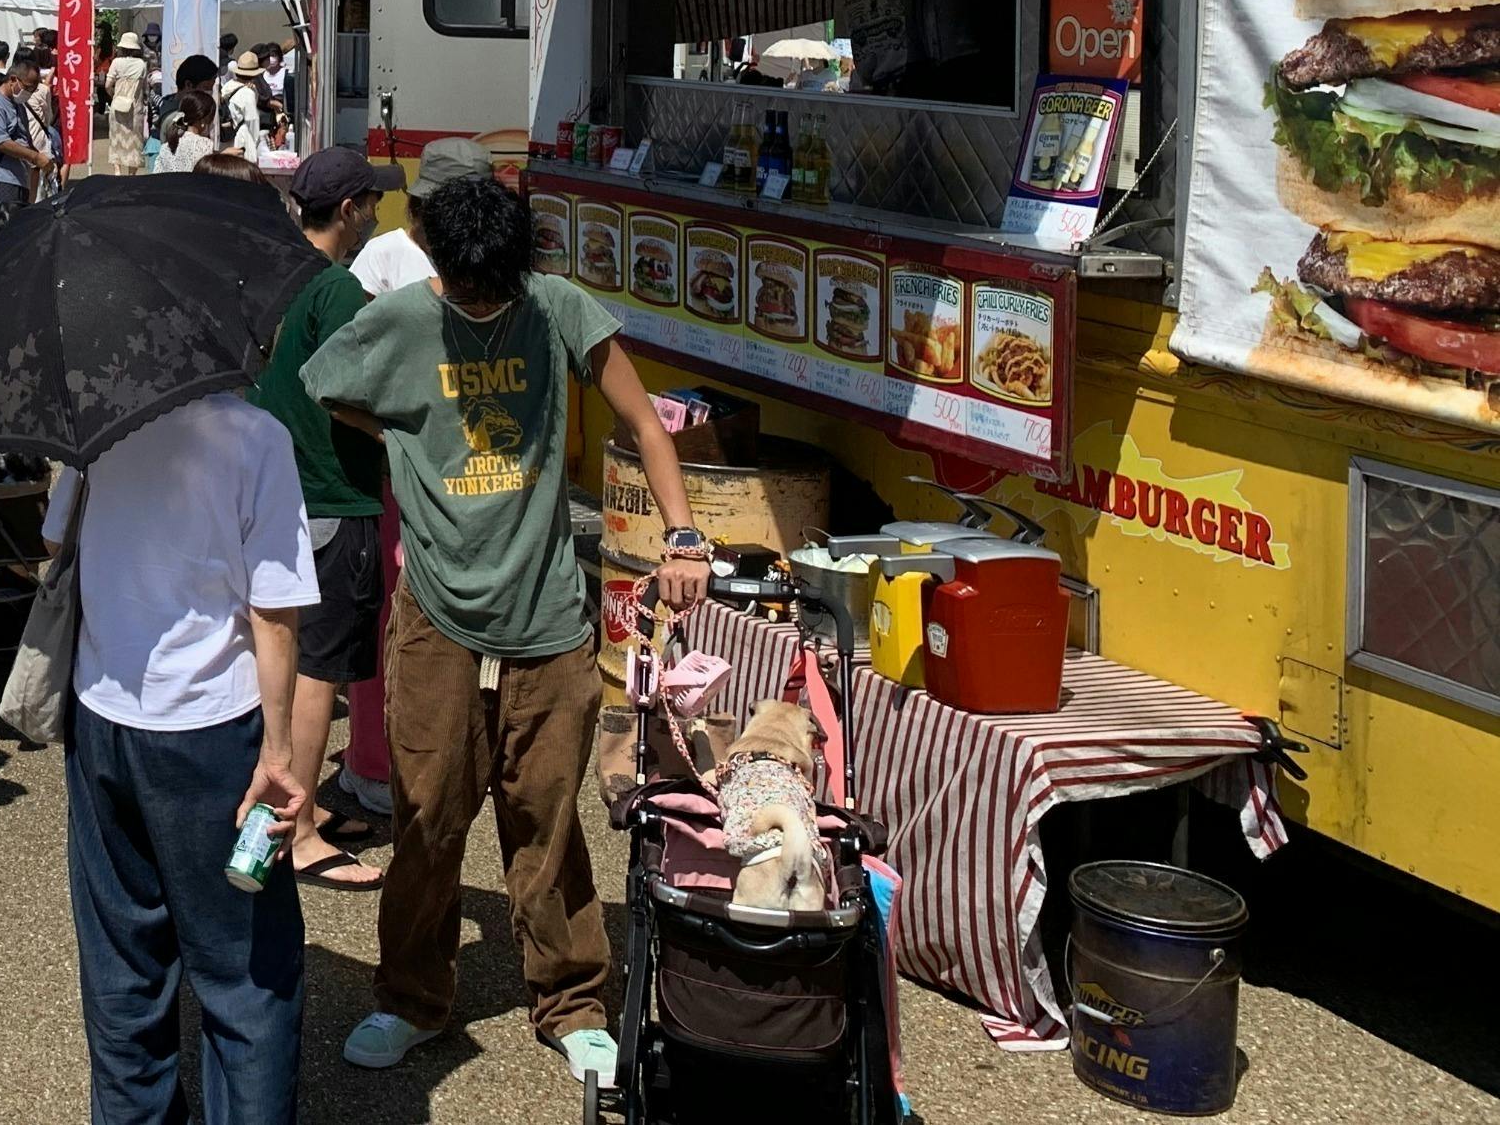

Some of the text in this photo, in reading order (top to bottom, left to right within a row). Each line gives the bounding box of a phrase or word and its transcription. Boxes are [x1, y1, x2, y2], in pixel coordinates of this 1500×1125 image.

[1055, 15, 1136, 66] Open
[1039, 94, 1115, 121] CORONA BEER
[1059, 208, 1087, 232] 500
[894, 277, 958, 306] FRENCH FRIES
[977, 292, 1049, 323] CHILI CURLY FRIES
[784, 352, 808, 374] 1200
[437, 357, 528, 398] USMC
[933, 392, 960, 421] 500
[1024, 416, 1051, 444] 700
[464, 453, 521, 475] JROTC
[443, 472, 524, 496] YONKERS
[1077, 1029, 1150, 1081] ACING
